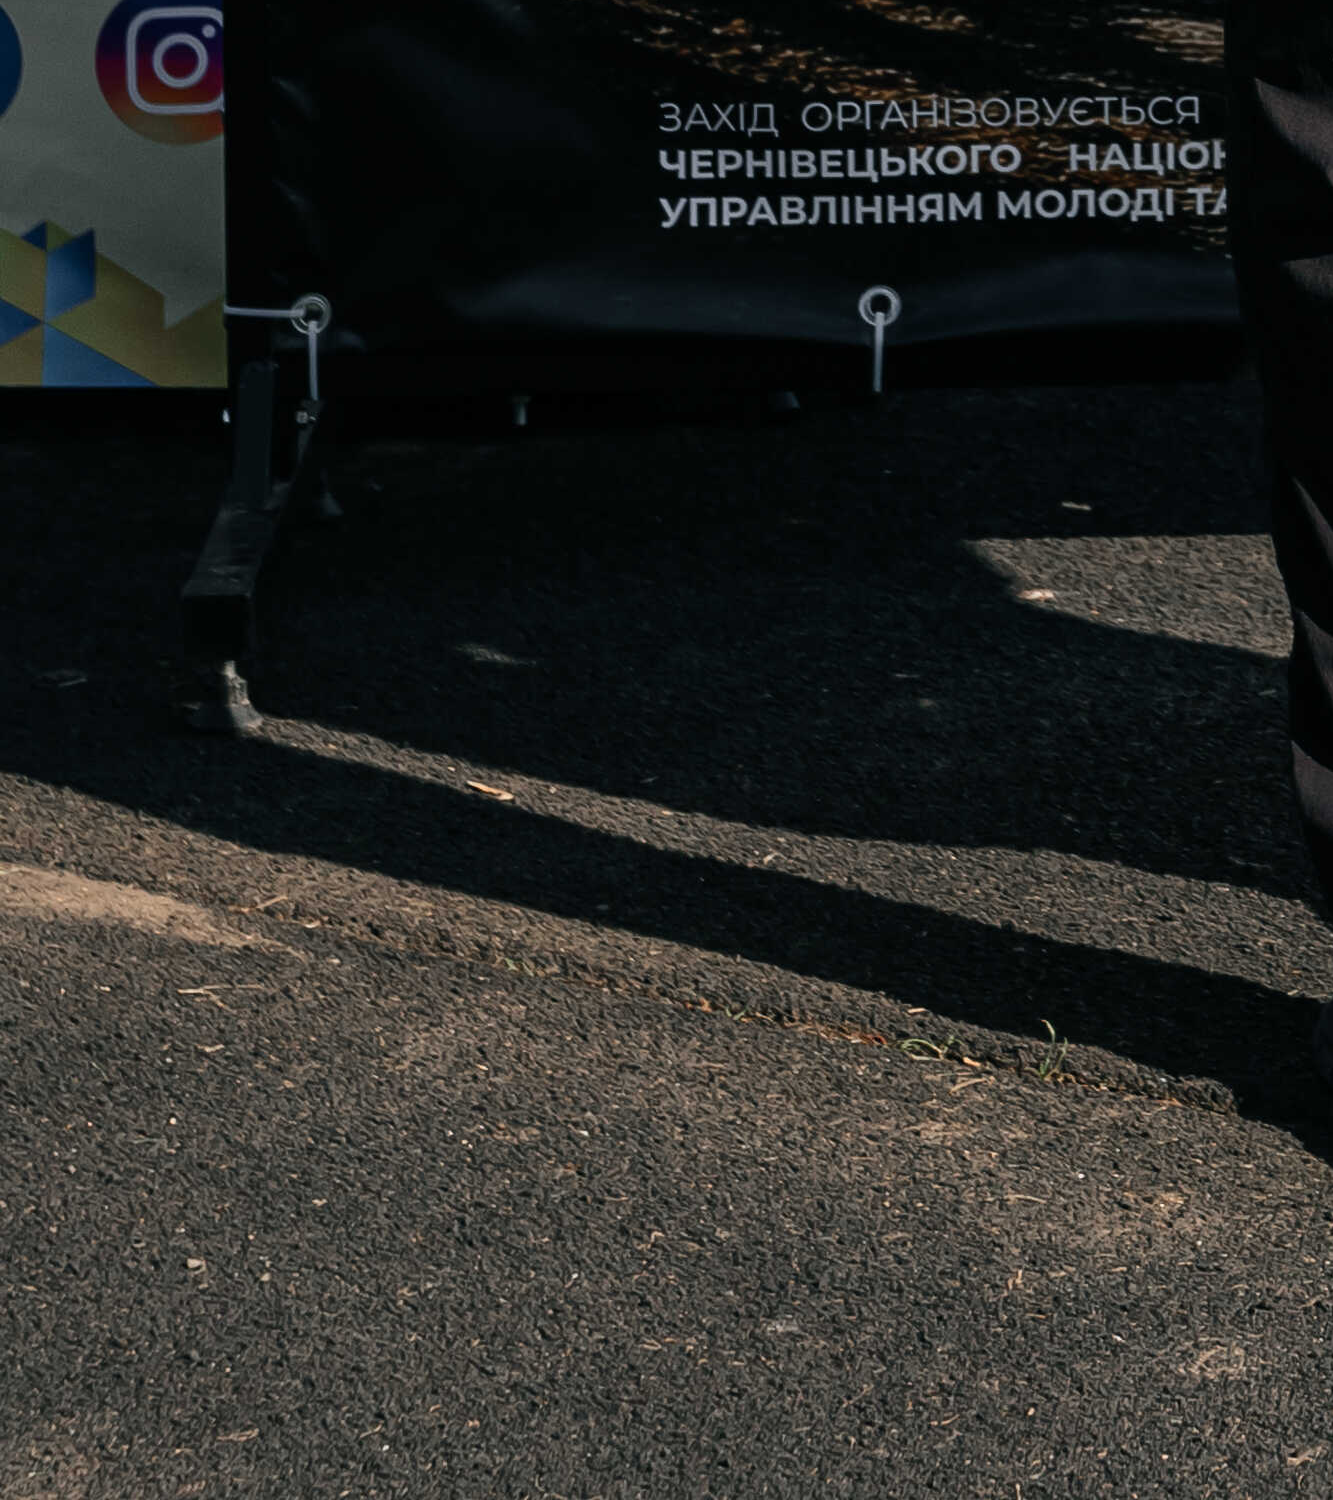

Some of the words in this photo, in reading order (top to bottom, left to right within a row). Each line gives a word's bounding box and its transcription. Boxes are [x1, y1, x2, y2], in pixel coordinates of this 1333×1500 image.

[659, 102, 780, 137] ЗАХІД
[801, 96, 1200, 132] ОРГАНІЗОВУЄТЬСЯ
[659, 144, 1022, 183] ЧЕРНІВЕЦЬКОГО
[659, 191, 983, 229] УПРАВЛІННЯМ
[997, 186, 1174, 223] МОЛОДІ
